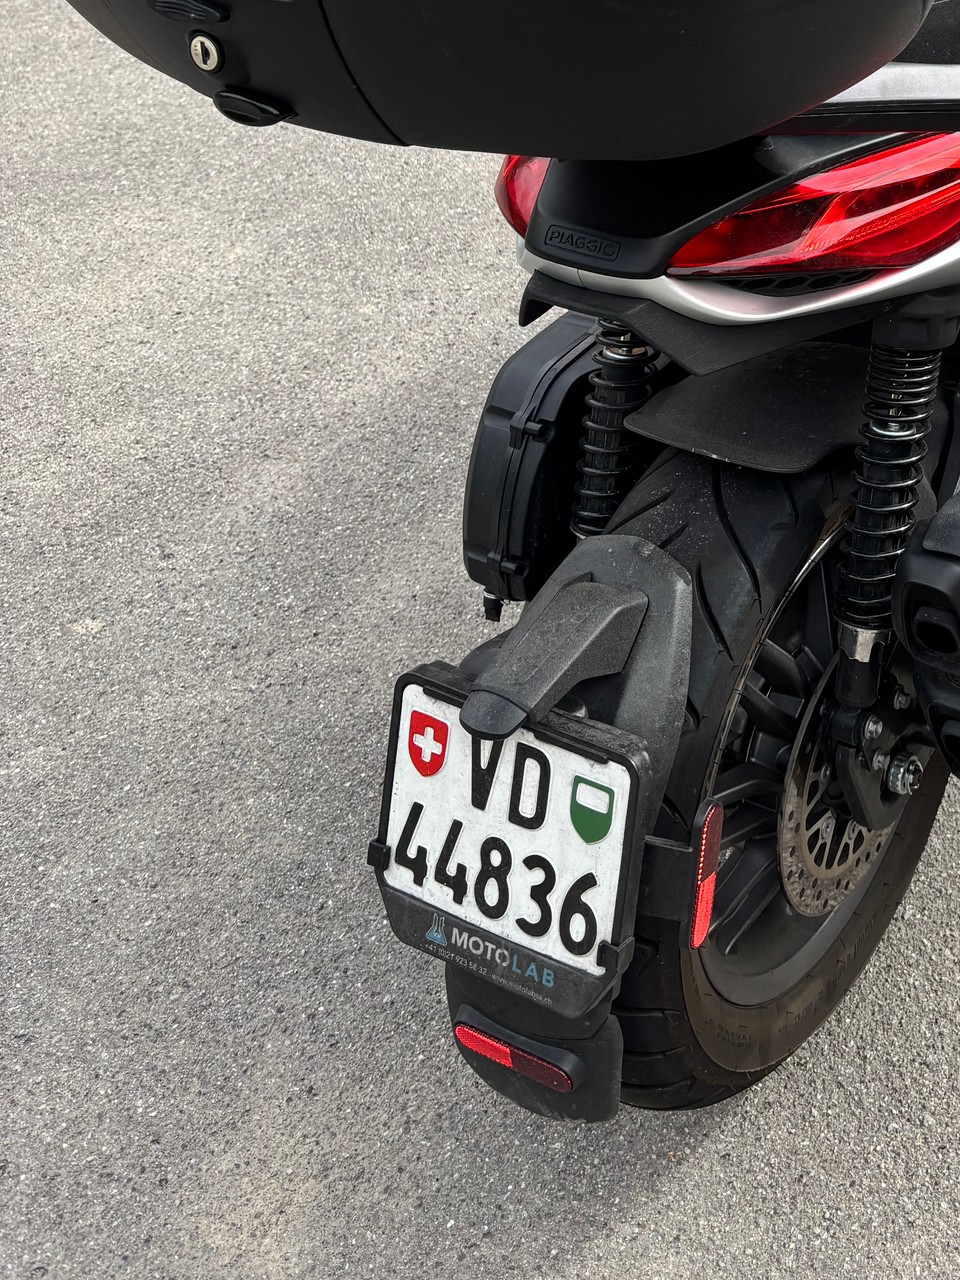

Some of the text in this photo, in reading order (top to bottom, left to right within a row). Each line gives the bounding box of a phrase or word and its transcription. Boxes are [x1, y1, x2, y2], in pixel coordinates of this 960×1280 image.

[549, 230, 616, 257] PIAGGIO
[471, 736, 552, 830] VD
[394, 801, 598, 956] 44836
